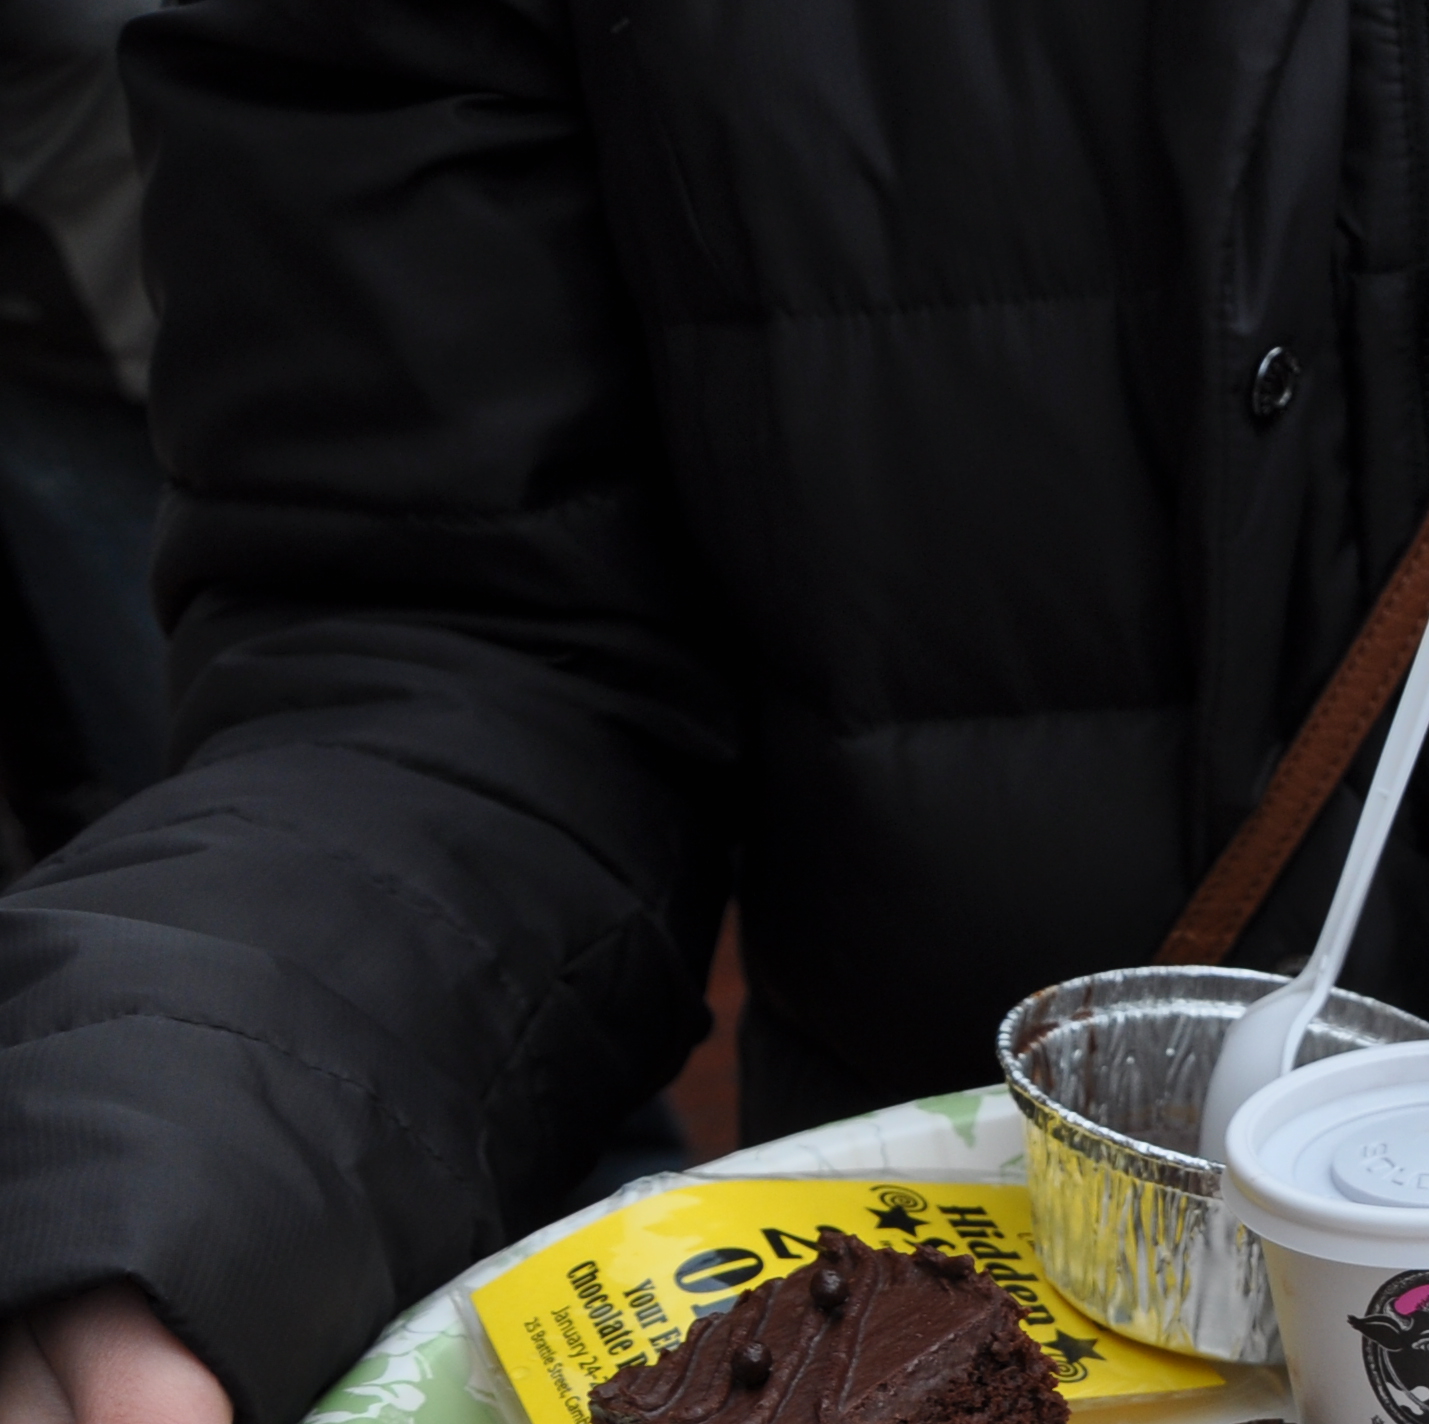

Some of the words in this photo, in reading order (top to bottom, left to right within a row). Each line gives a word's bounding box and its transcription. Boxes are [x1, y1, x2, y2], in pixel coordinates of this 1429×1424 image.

[936, 1205, 1056, 1326] Hidden
[524, 1316, 538, 1334] 25
[566, 1260, 635, 1357] Chocolate
[623, 1278, 669, 1330] Your
[530, 1326, 555, 1367] Brattle
[551, 1305, 590, 1360] January
[546, 1363, 573, 1400] Street,
